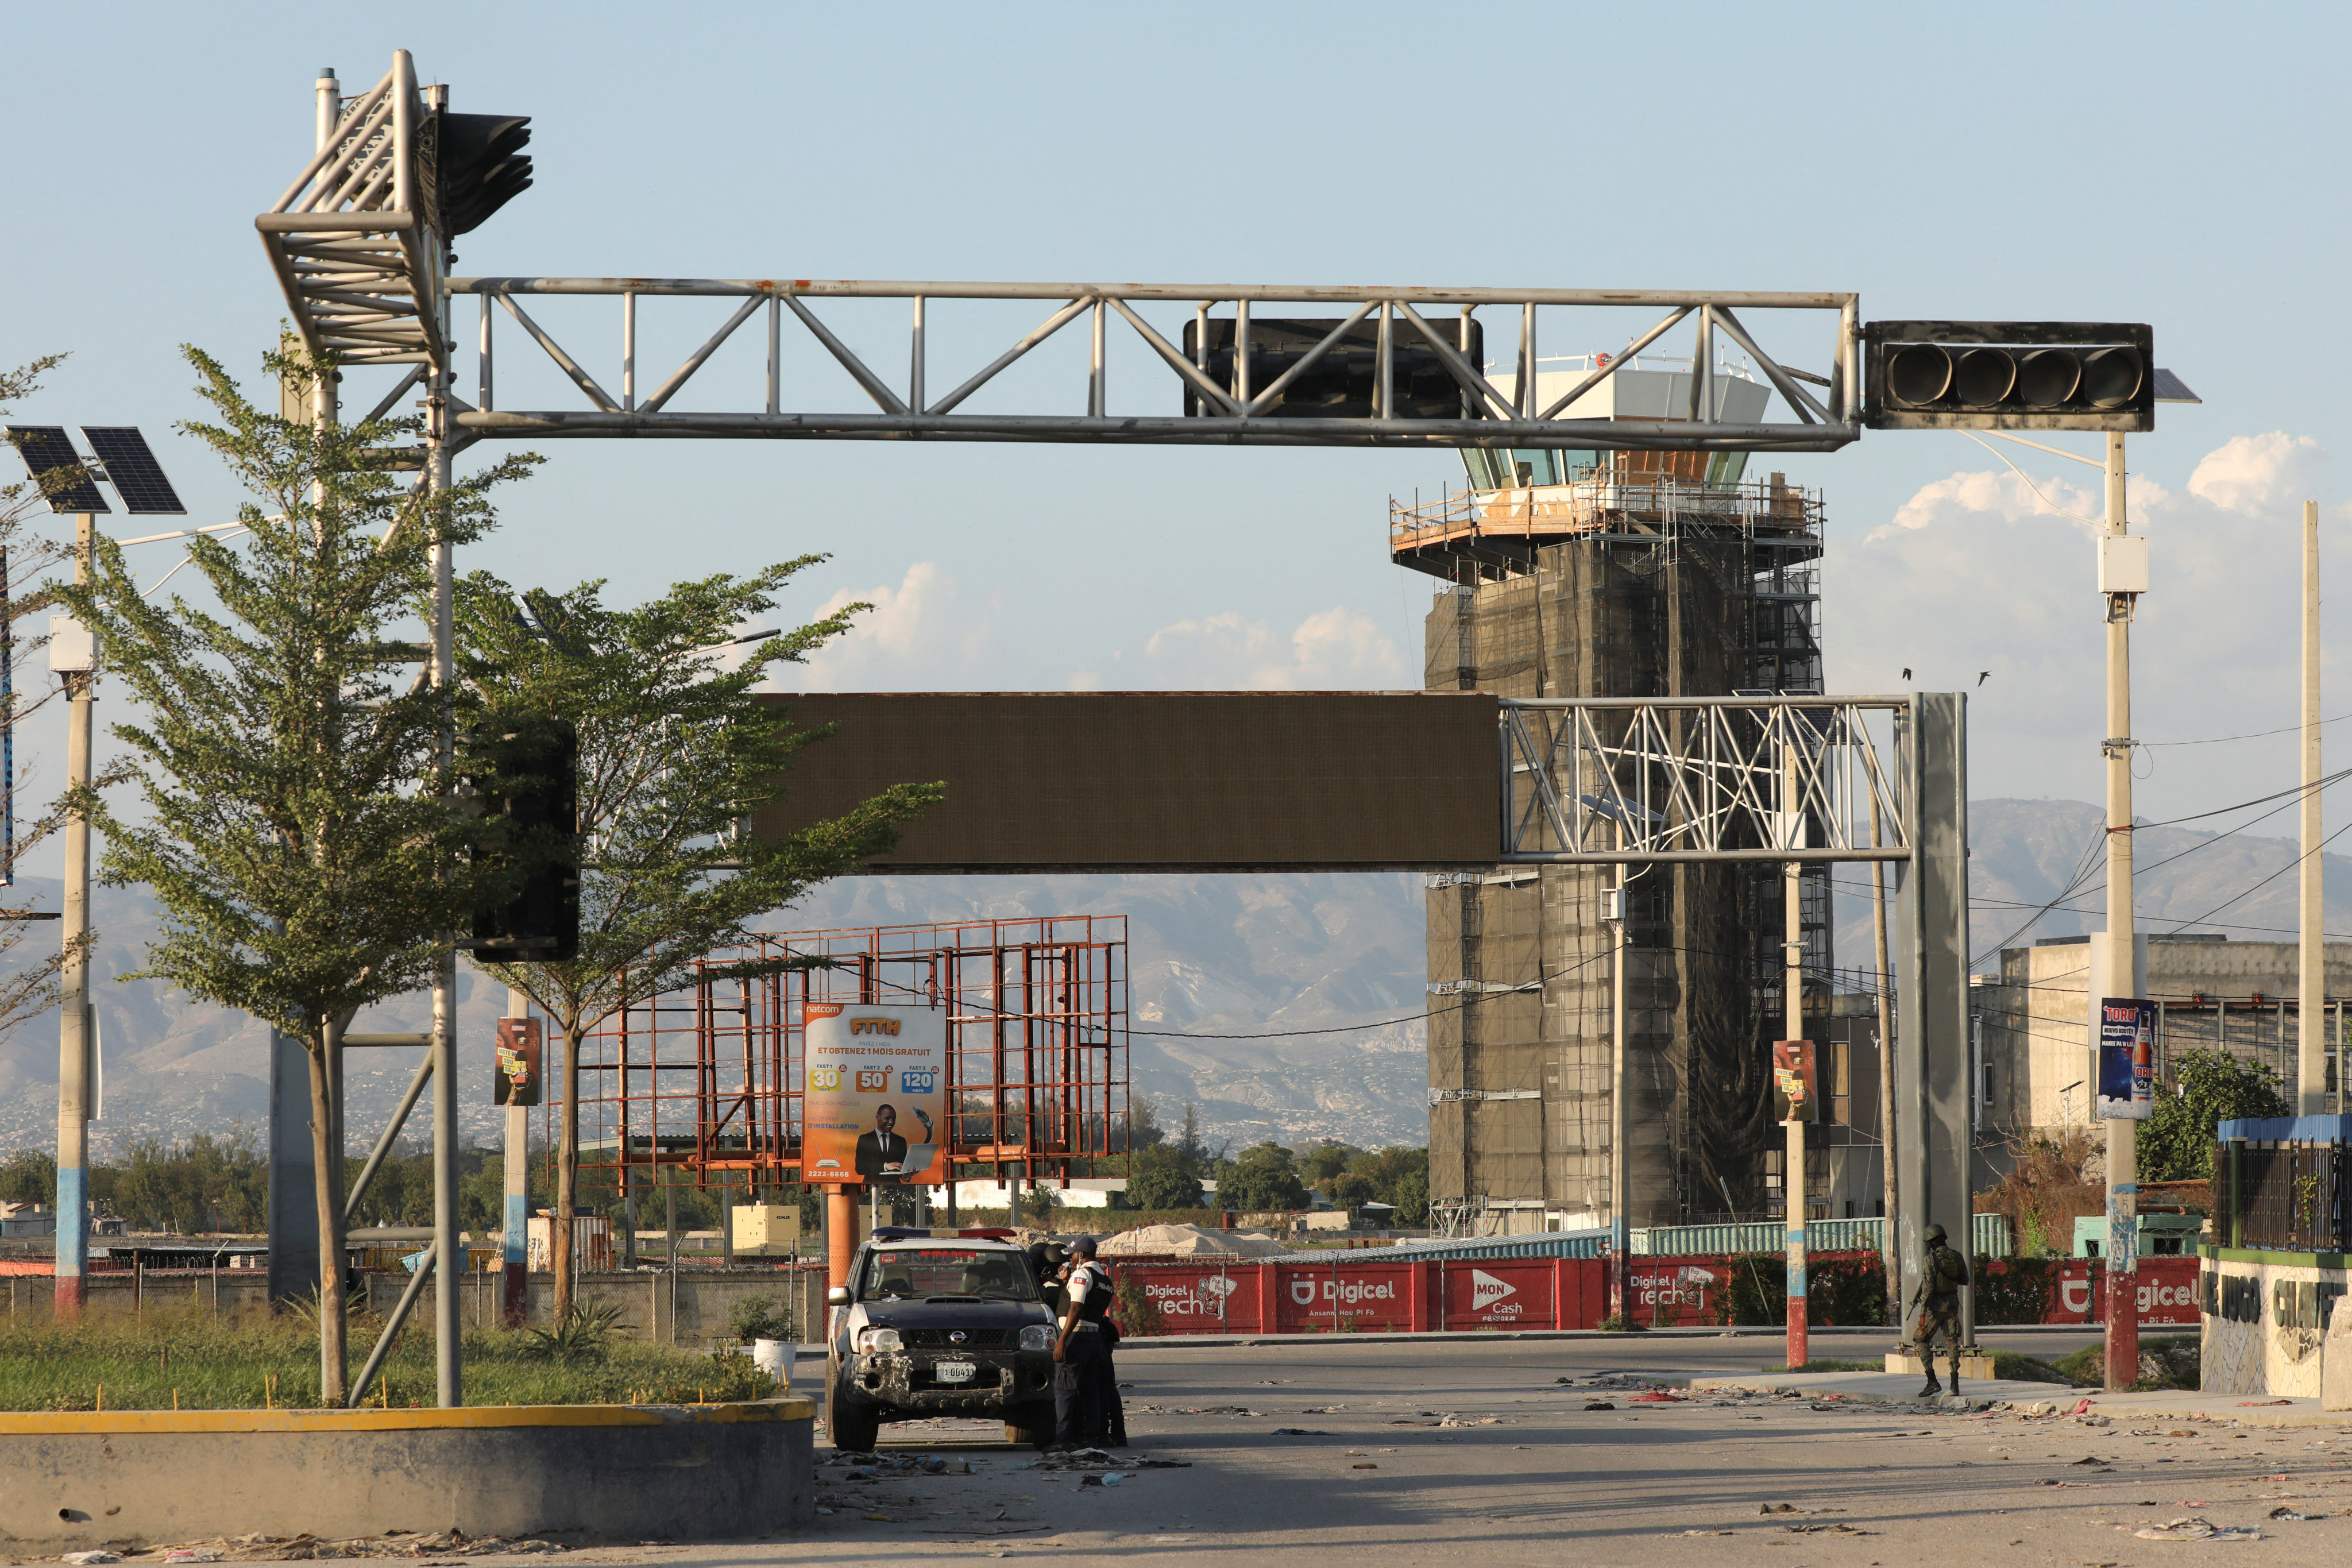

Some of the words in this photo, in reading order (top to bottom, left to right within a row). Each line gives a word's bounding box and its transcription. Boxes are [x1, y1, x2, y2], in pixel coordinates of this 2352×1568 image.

[2103, 1006, 2139, 1022] TORO
[850, 1018, 901, 1036] FTTH
[813, 1071, 837, 1087] 30
[861, 1072, 883, 1087] 50
[903, 1073, 932, 1087] 120
[1477, 1284, 1505, 1295] MON
[1631, 1275, 1670, 1289] Digicel
[1145, 1284, 1188, 1299] Digicel
[1323, 1280, 1396, 1304] Digicel
[1492, 1302, 1523, 1314] Cash
